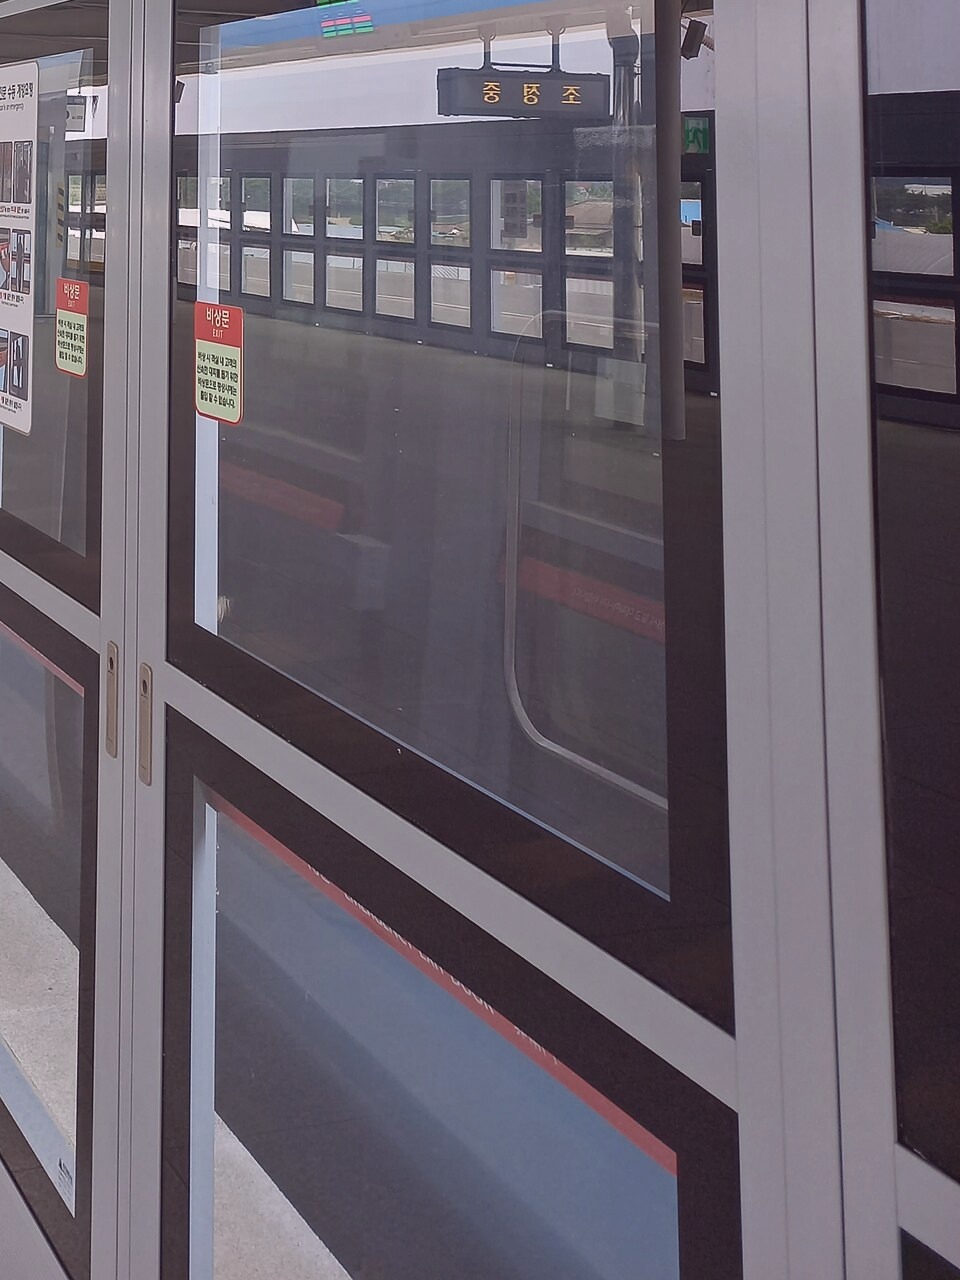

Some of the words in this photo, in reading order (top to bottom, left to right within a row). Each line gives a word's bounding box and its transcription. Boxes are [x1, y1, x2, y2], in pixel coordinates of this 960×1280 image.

[64, 282, 80, 300] 비상문
[206, 307, 230, 328] 비상문
[212, 328, 224, 338] EXIT
